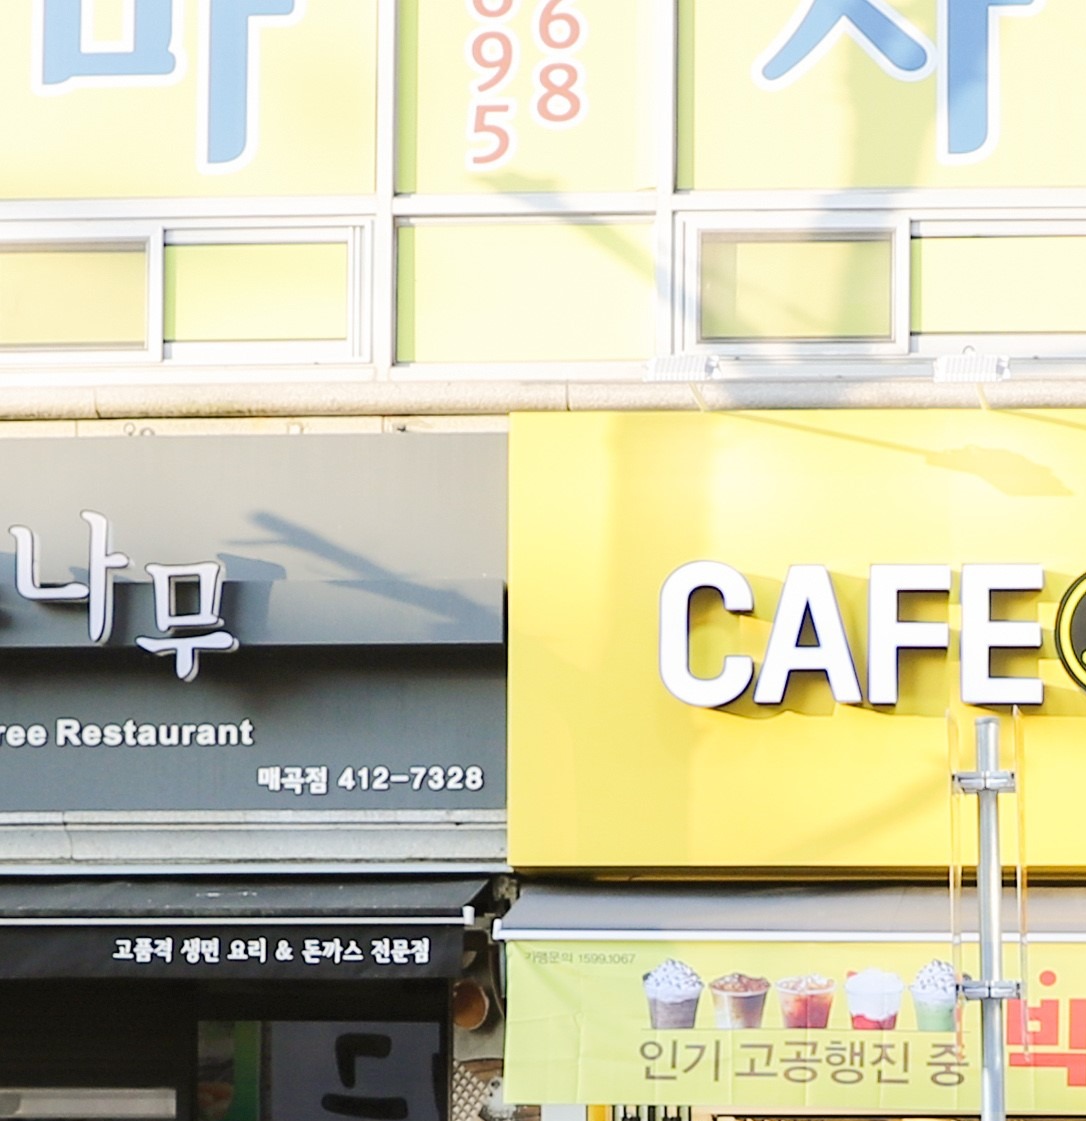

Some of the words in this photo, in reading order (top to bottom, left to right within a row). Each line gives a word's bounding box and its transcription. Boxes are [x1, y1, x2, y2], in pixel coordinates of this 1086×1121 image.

[9, 510, 239, 681] 나무
[657, 559, 1043, 709] CAFE
[56, 719, 254, 747] Restaurant
[257, 766, 328, 794] 매곡점
[337, 766, 484, 791] 412-7328
[112, 938, 174, 963] 고품격
[180, 938, 220, 963] 생면
[226, 938, 268, 963] 요리
[275, 939, 294, 962] &
[301, 938, 364, 963] 돈까스
[370, 938, 431, 963] 전문점
[639, 1039, 721, 1082] 인기
[734, 1039, 913, 1085] 고공행진
[926, 1041, 971, 1087] 중
